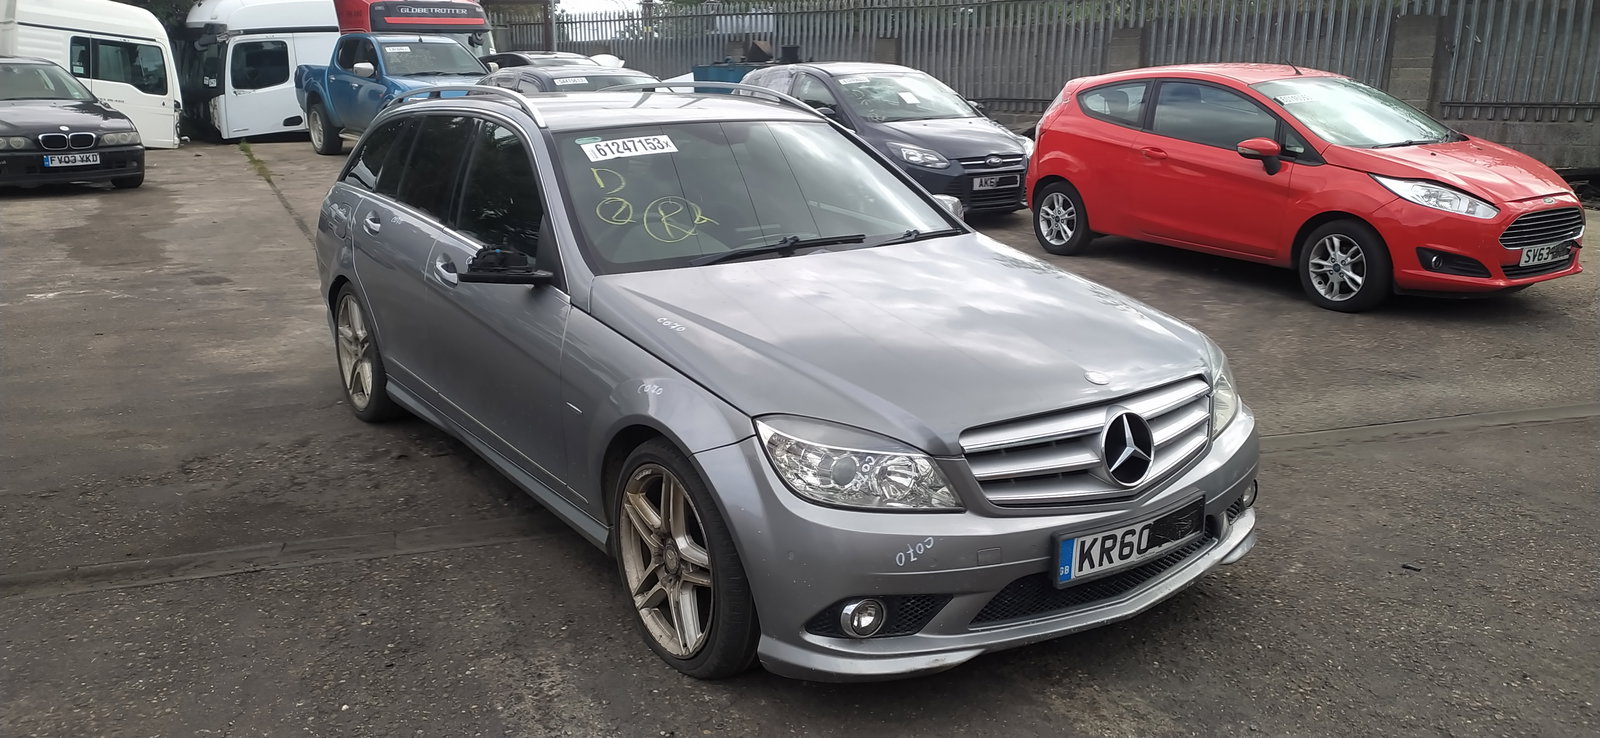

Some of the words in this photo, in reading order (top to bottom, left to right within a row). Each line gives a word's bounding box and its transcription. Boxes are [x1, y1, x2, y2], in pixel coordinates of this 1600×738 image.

[400, 7, 468, 15] GLOBETROTTER
[50, 155, 77, 165] FV03
[79, 153, 98, 163] YKD
[1524, 246, 1551, 263] SV63
[1059, 564, 1070, 577] GB
[1077, 522, 1152, 573] KR60
